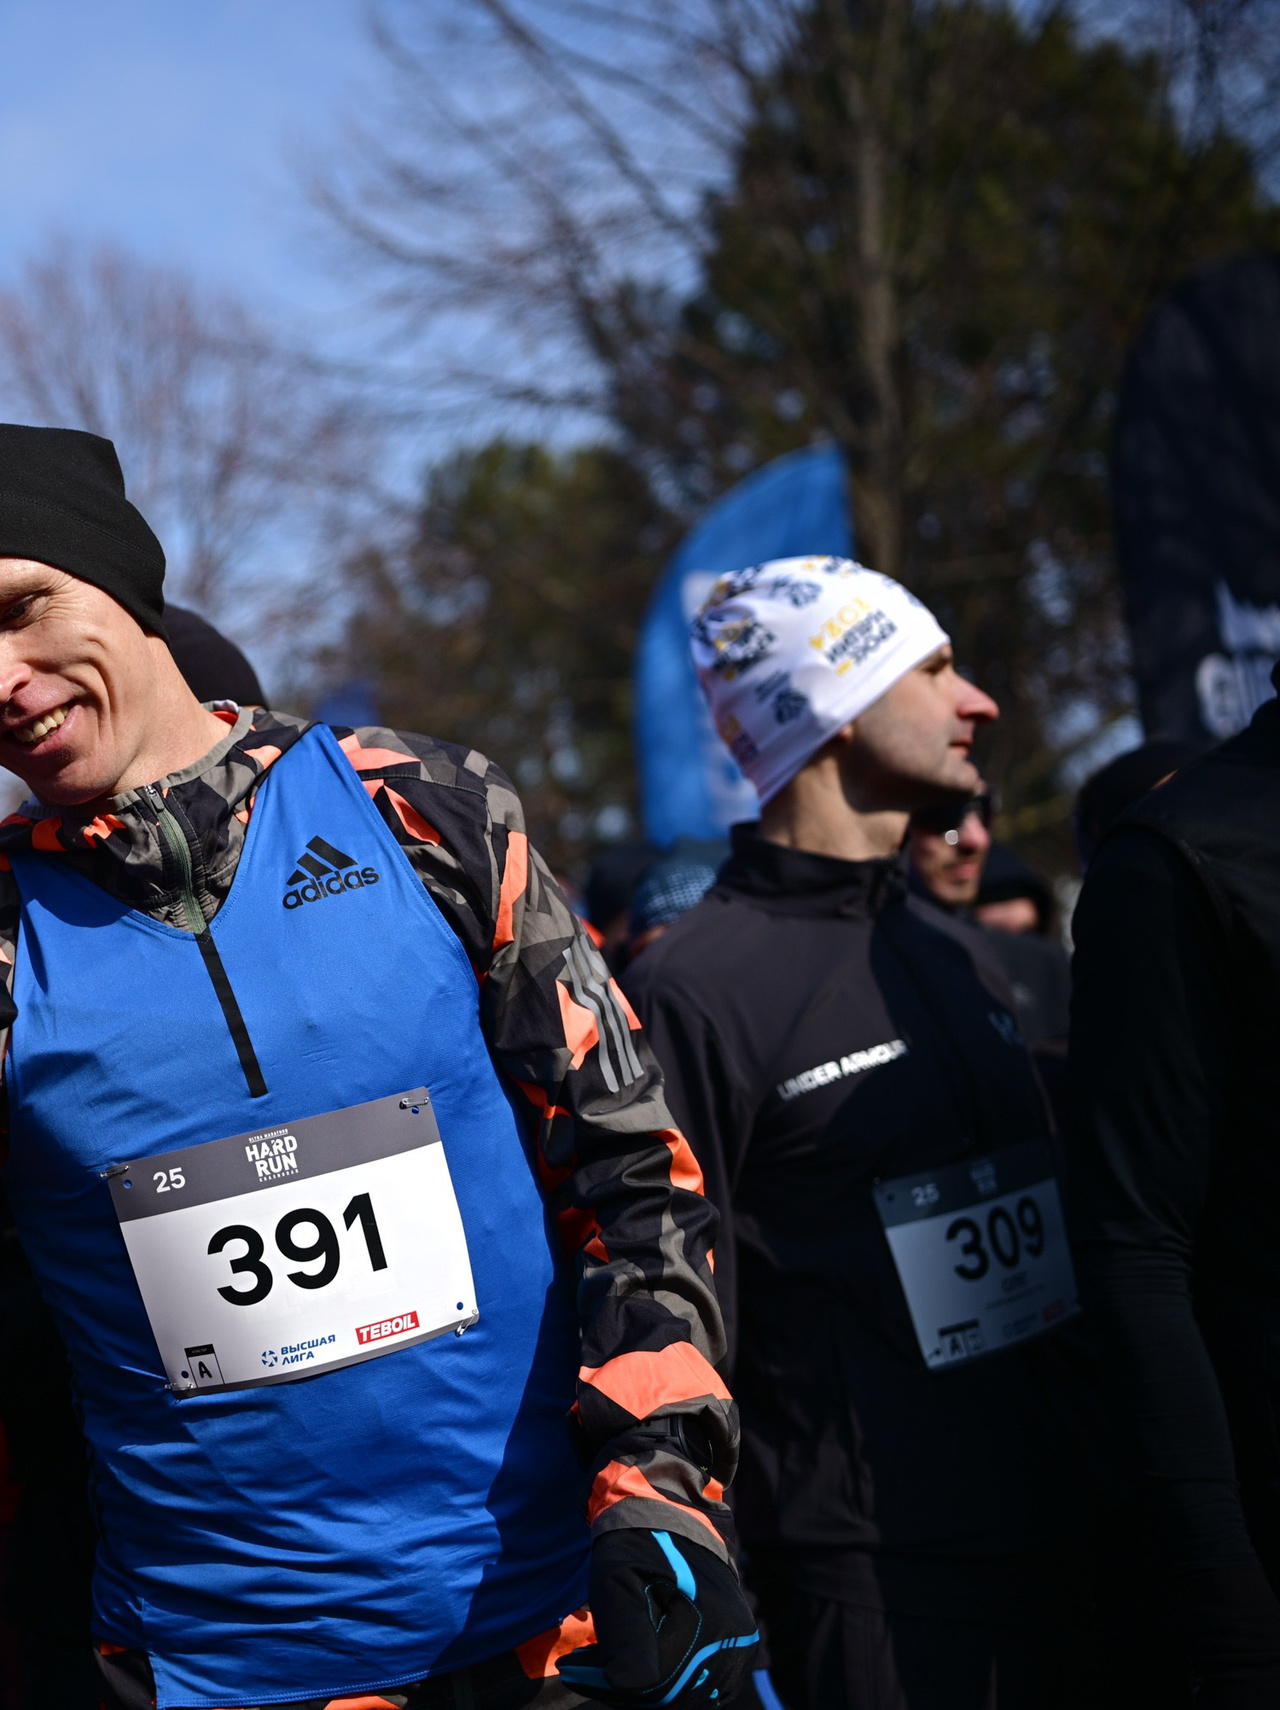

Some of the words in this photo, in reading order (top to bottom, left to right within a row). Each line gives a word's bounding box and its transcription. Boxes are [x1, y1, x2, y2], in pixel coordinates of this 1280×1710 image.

[282, 867, 380, 910] adidas
[776, 1060, 842, 1101] UNDER
[840, 1039, 908, 1077] ARMOUR
[245, 1135, 298, 1163] HARD
[255, 1152, 298, 1178] RUN
[152, 1167, 186, 1194] 25
[910, 1182, 941, 1207] 25
[207, 1192, 388, 1307] 391
[946, 1196, 1044, 1282] 309
[360, 1314, 416, 1342] TEBOIL
[280, 1334, 336, 1355] ВЫСШАЯ
[282, 1350, 315, 1366] ЛИГА
